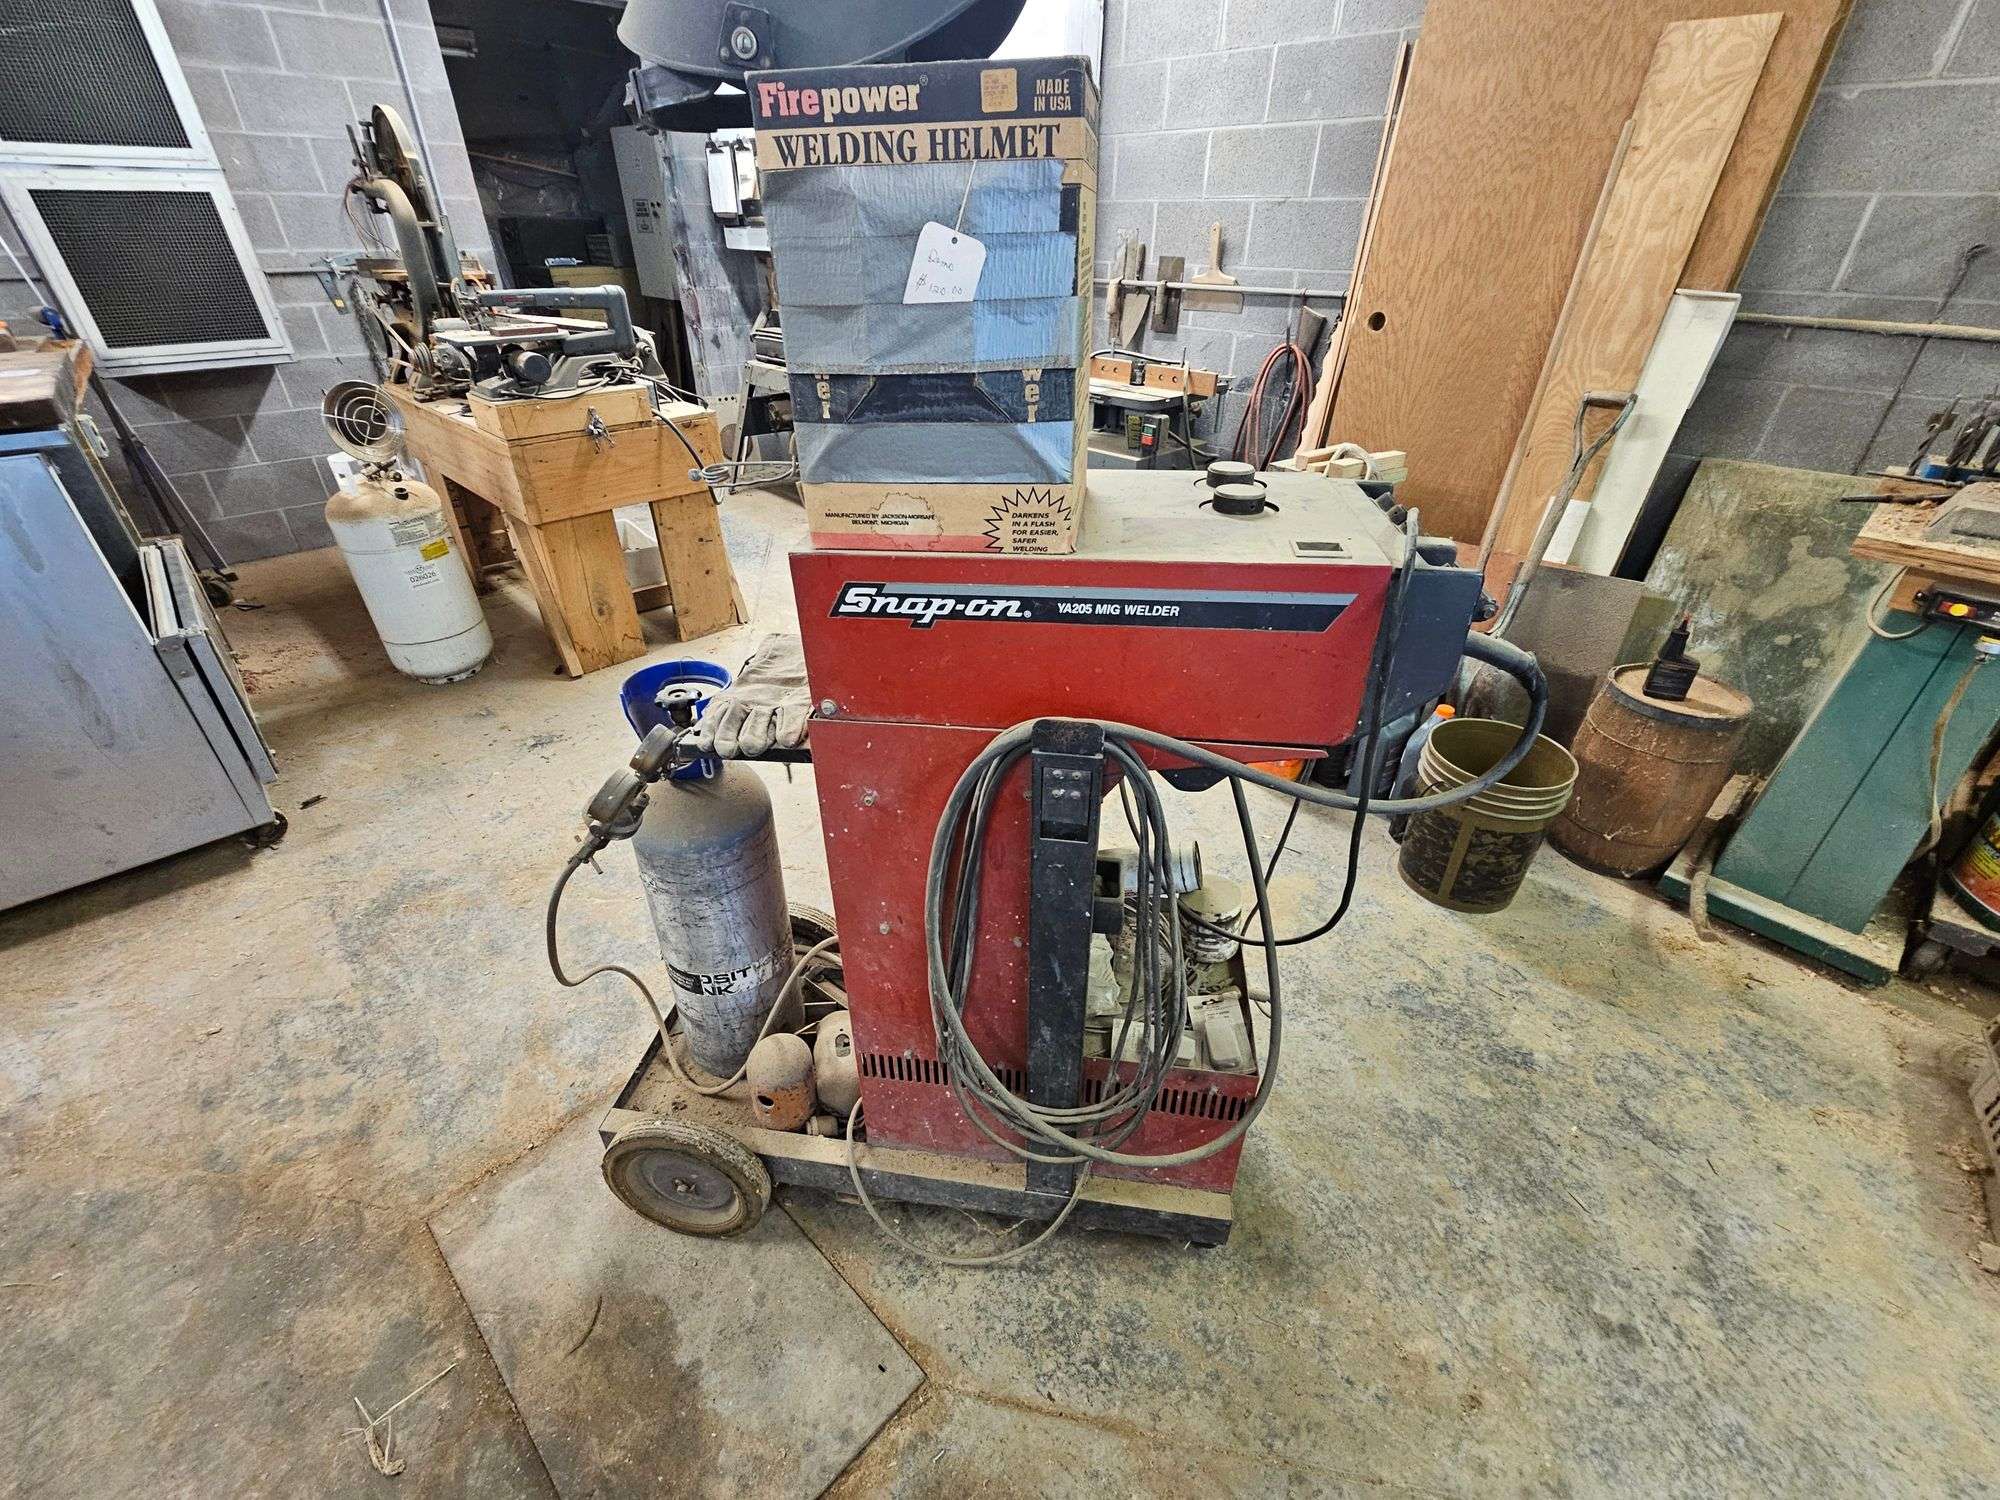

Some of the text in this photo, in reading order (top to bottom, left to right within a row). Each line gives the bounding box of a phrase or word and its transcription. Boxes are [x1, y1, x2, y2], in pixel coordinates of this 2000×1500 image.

[1036, 78, 1070, 95] MADE
[1033, 95, 1072, 112] IN USA
[771, 123, 1061, 167] WELDING HELMET
[824, 512, 871, 520] MANUFACTURED
[880, 519, 910, 527] MICHIGAN
[1057, 602, 1093, 615] YA205
[1095, 603, 1121, 615] MIG
[1124, 604, 1180, 617] WELDER
